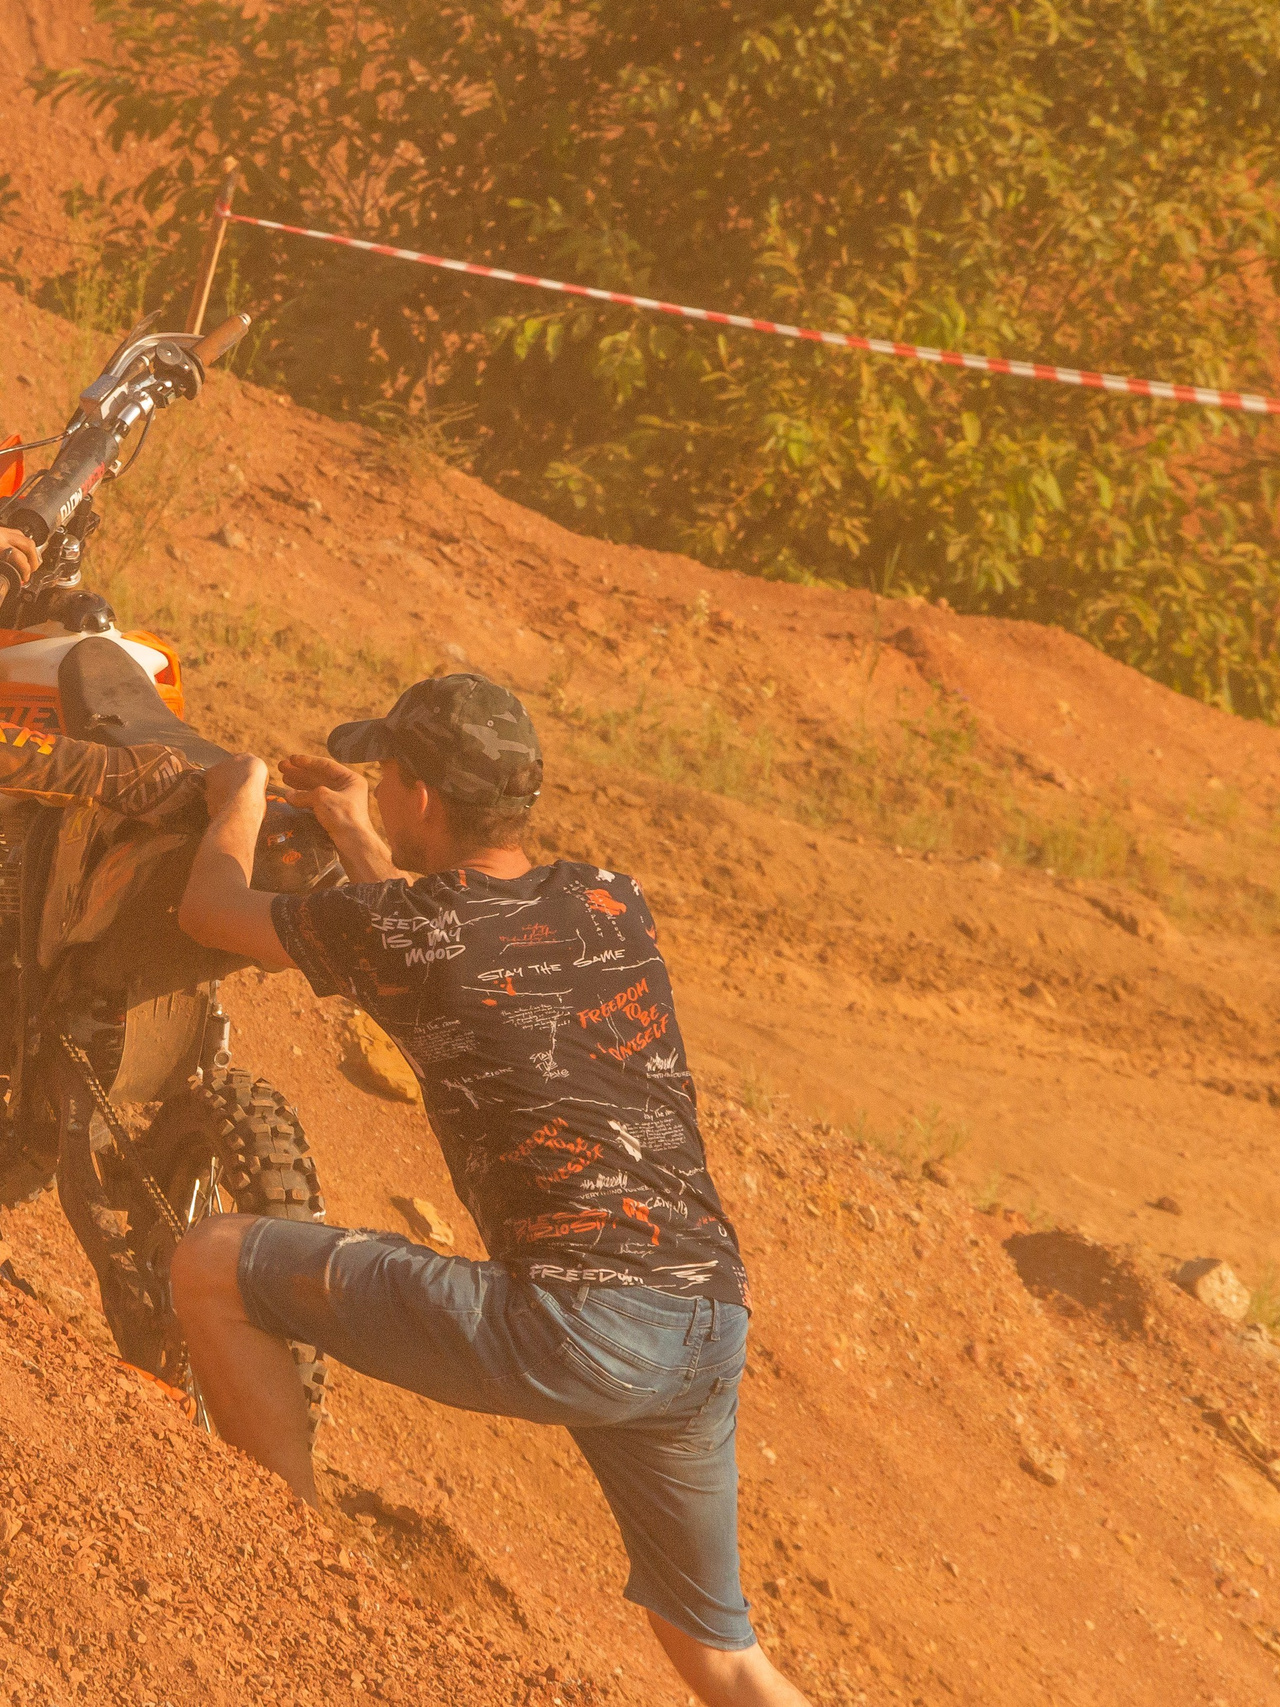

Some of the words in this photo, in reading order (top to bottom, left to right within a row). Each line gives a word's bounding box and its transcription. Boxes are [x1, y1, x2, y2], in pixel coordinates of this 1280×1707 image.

[381, 933, 412, 950] IS
[405, 944, 466, 968] MOOD
[477, 966, 523, 982] STAY
[528, 961, 562, 976] THE
[573, 949, 626, 968] SAME
[577, 977, 649, 1029] FREEDOM
[622, 1003, 641, 1021] TO
[639, 1003, 660, 1027] BE
[608, 1013, 670, 1061] ONESELF
